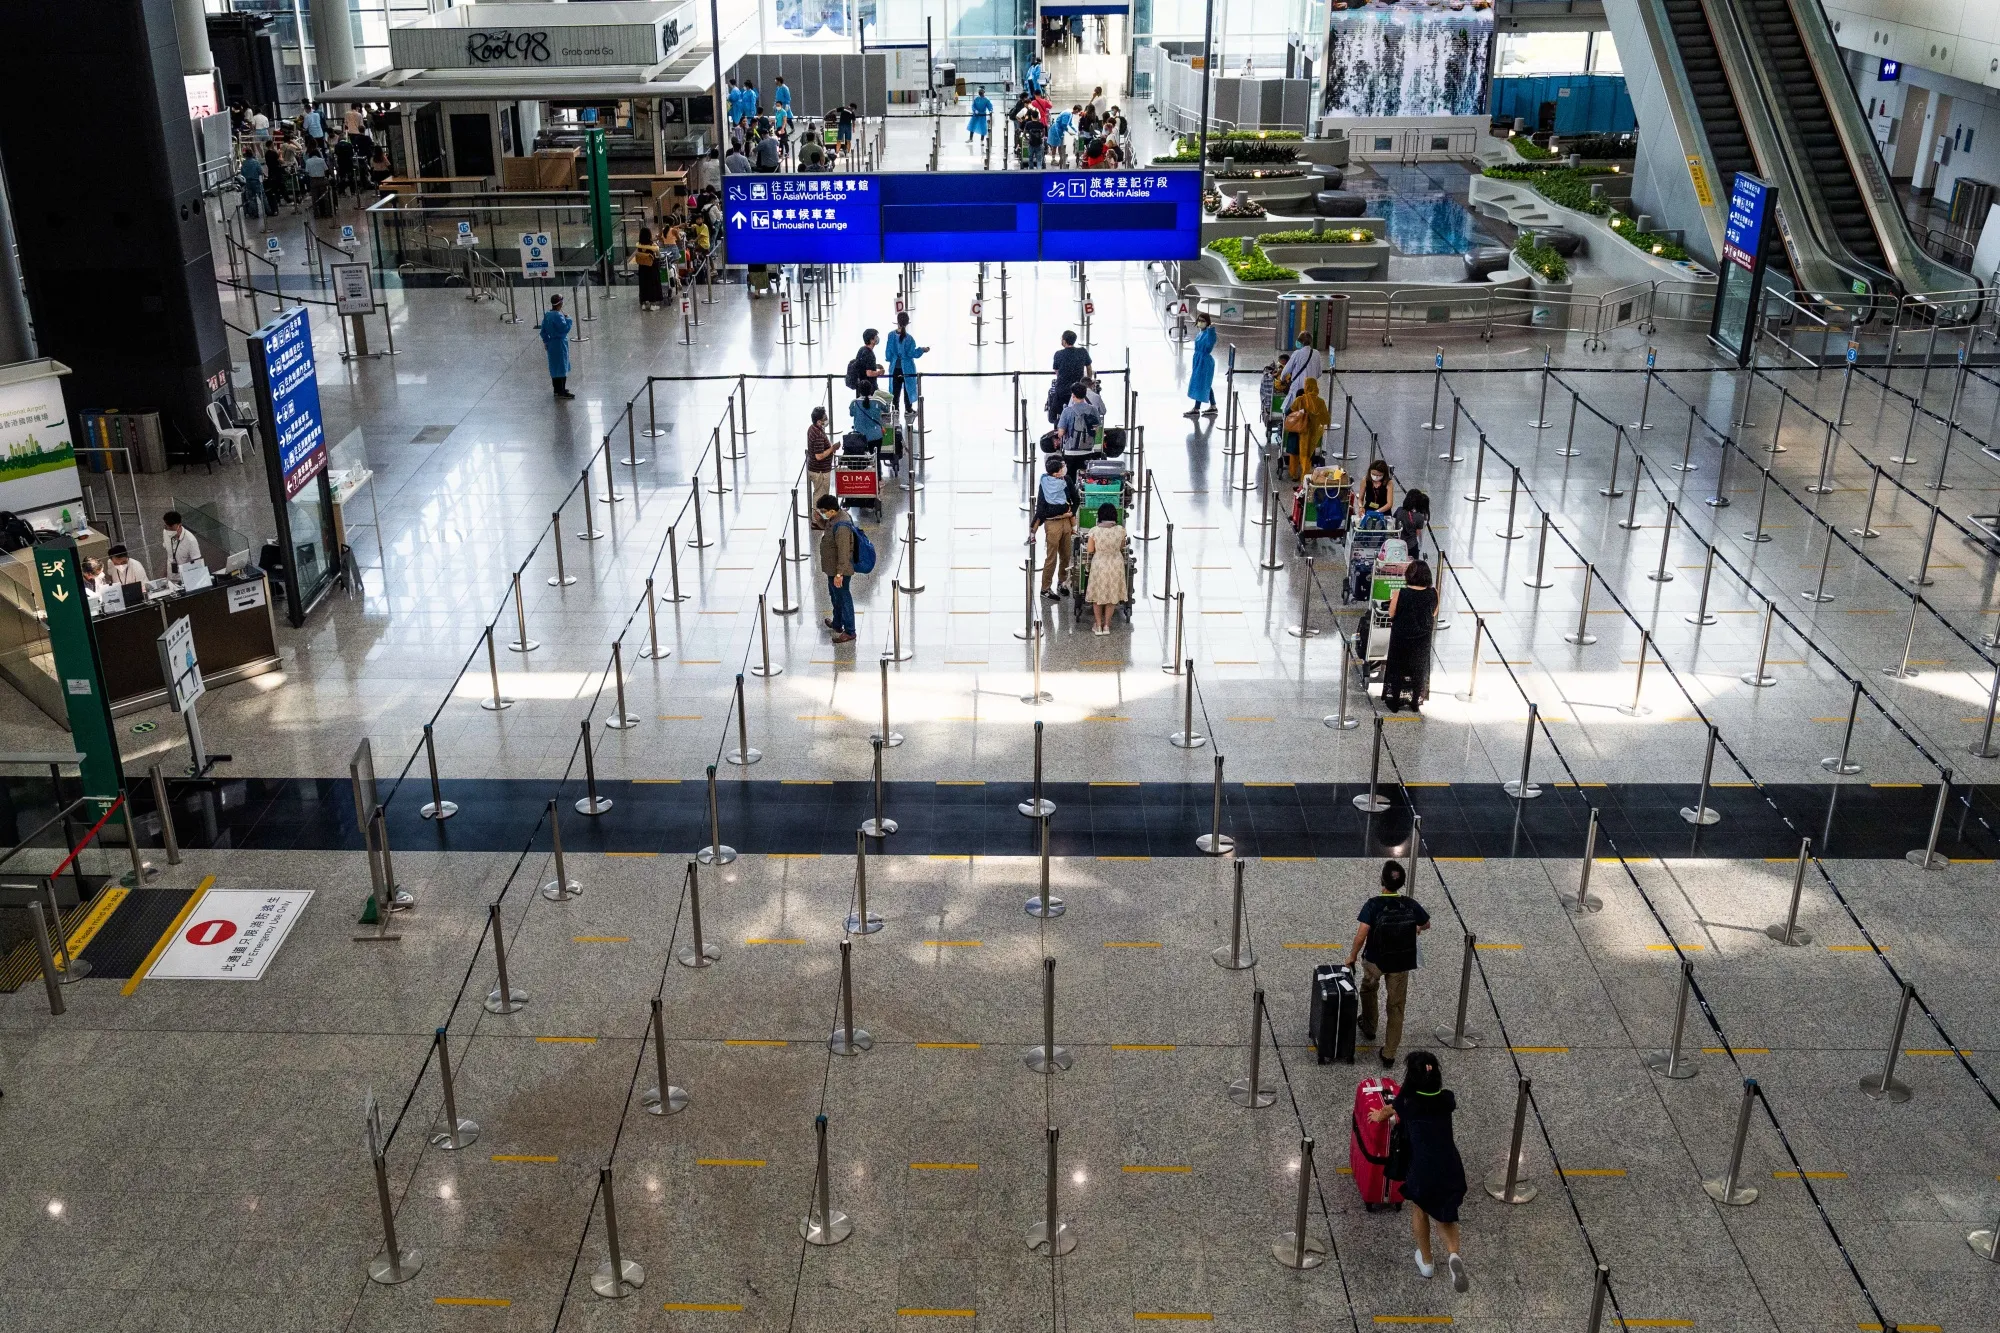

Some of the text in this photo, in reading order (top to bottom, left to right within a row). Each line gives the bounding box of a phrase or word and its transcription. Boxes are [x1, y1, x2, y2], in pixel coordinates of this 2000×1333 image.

[561, 47, 614, 57] Grab and Go
[770, 179, 870, 192] 往亞洲國際博覽館
[1070, 182, 1086, 194] T1
[1089, 176, 1169, 189] 旅客登記行段
[771, 191, 847, 202] To AsiaWorld-Expo
[1089, 188, 1151, 198] Check-in Aisles
[771, 208, 836, 221] 專車候車室
[772, 221, 848, 231] Limousine Lounge
[682, 302, 690, 313] F
[781, 301, 789, 312] E
[895, 301, 904, 312] D
[971, 303, 982, 315] C
[1084, 302, 1095, 314] B
[1178, 303, 1189, 314] A
[27, 404, 47, 413] Airport
[241, 900, 293, 967] For Emergency Use Only
